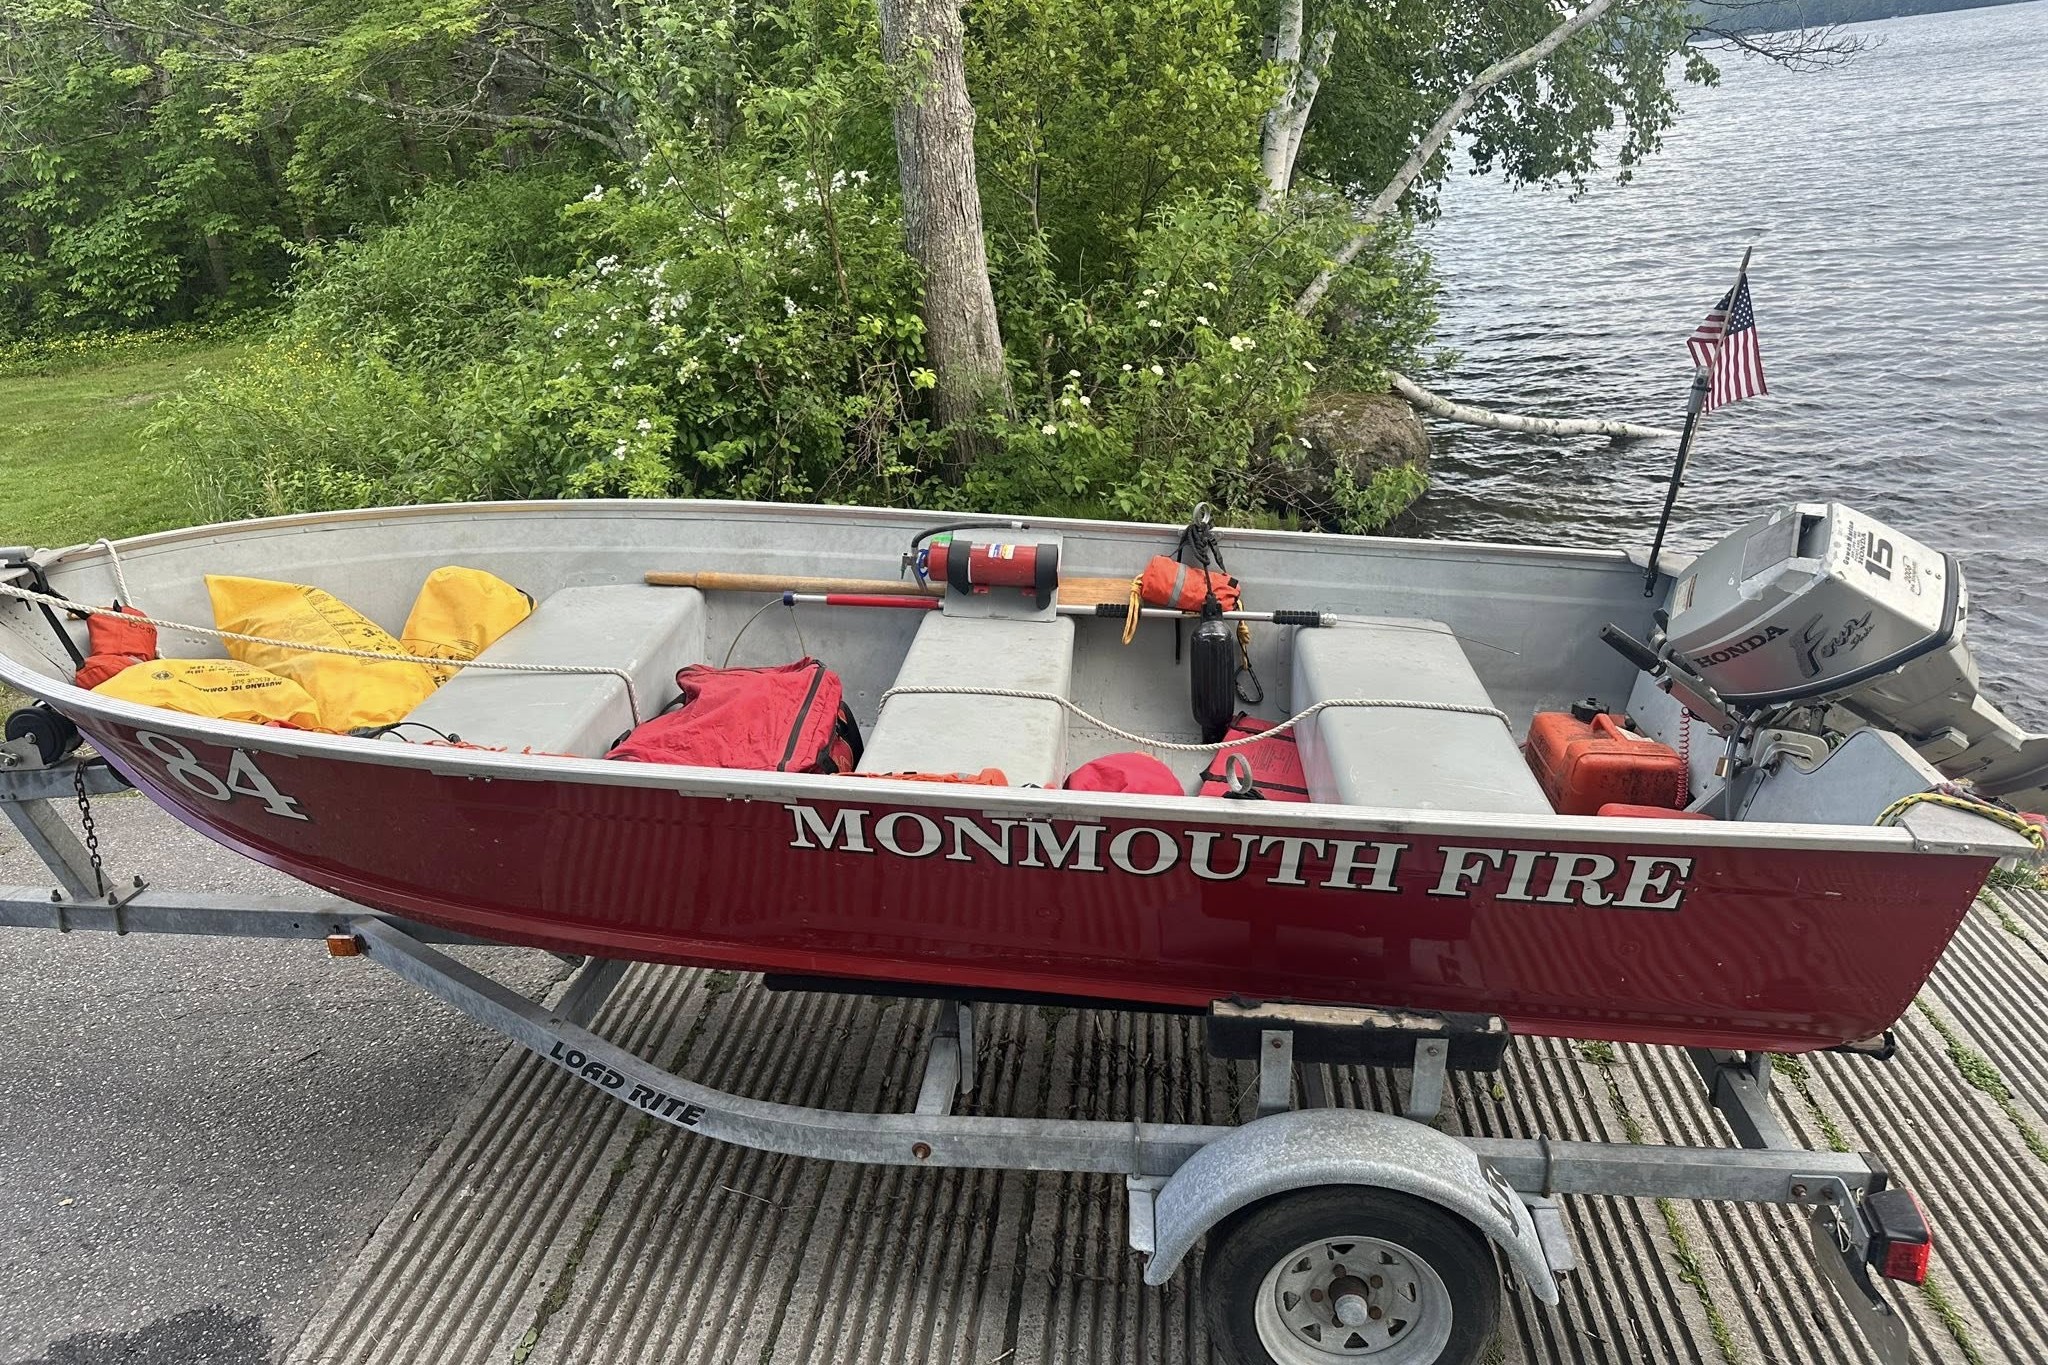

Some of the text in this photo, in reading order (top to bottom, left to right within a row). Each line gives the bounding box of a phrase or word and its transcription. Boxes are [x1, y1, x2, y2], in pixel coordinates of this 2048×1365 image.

[1858, 533, 1866, 565] HONDA
[1865, 531, 1893, 581] 15
[1693, 625, 1789, 669] HONDA
[245, 681, 283, 690] MUSTANG
[136, 730, 309, 821] 84
[786, 804, 1694, 912] MONMOUTH FIRE
[550, 1040, 706, 1127] LOAD RITE
